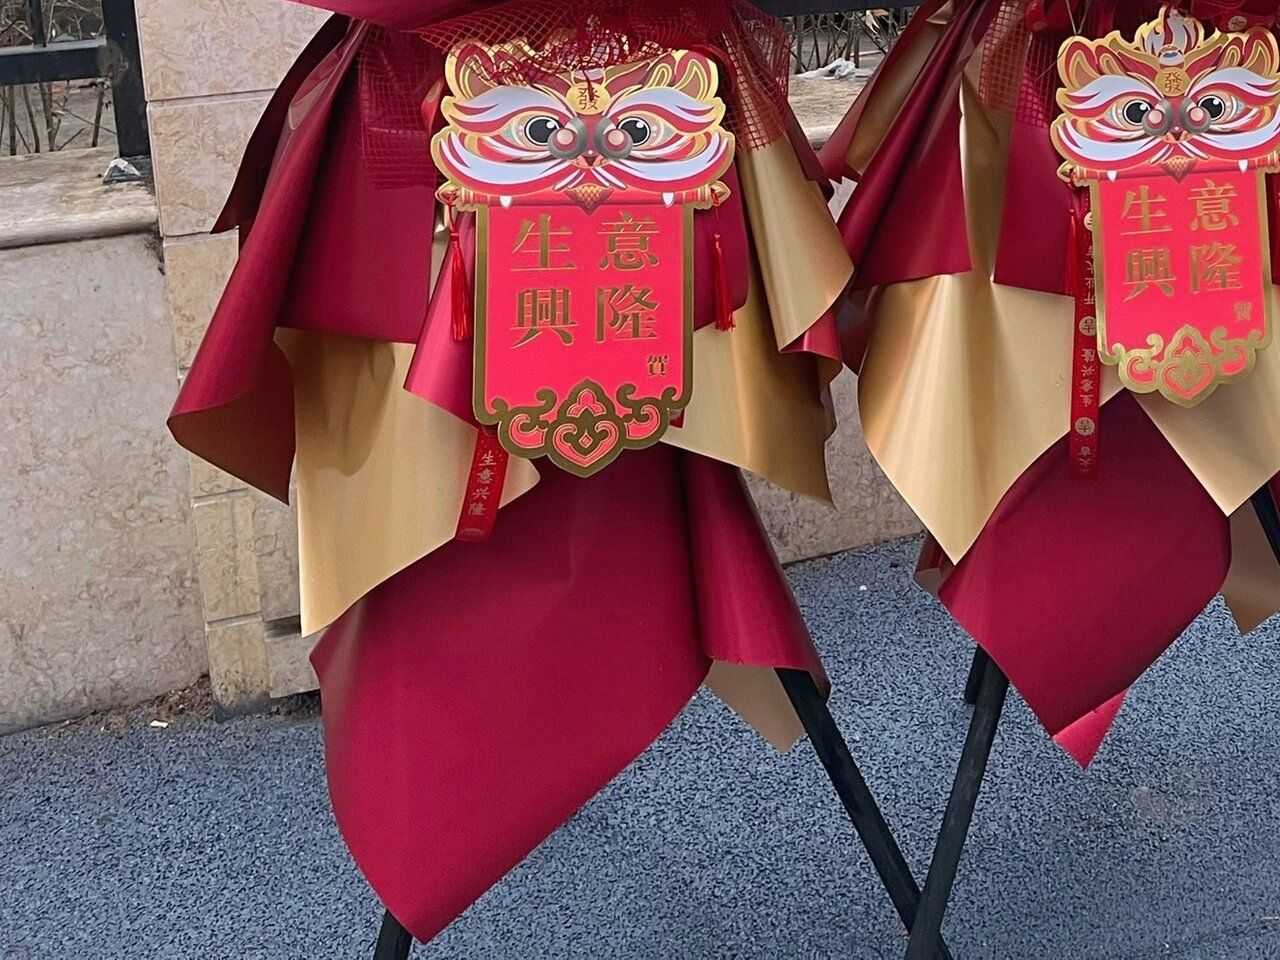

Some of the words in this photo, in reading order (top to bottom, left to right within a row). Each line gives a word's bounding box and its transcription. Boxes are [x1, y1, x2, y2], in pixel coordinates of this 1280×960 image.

[1163, 71, 1182, 92] 發
[1119, 179, 1240, 238] 生意
[510, 210, 660, 273] 生意
[1123, 242, 1244, 303] 興隆
[510, 285, 660, 349] 興隆
[646, 355, 668, 377] 賀
[1080, 348, 1096, 407] 生意兴隆
[468, 450, 497, 516] 生意兴隆
